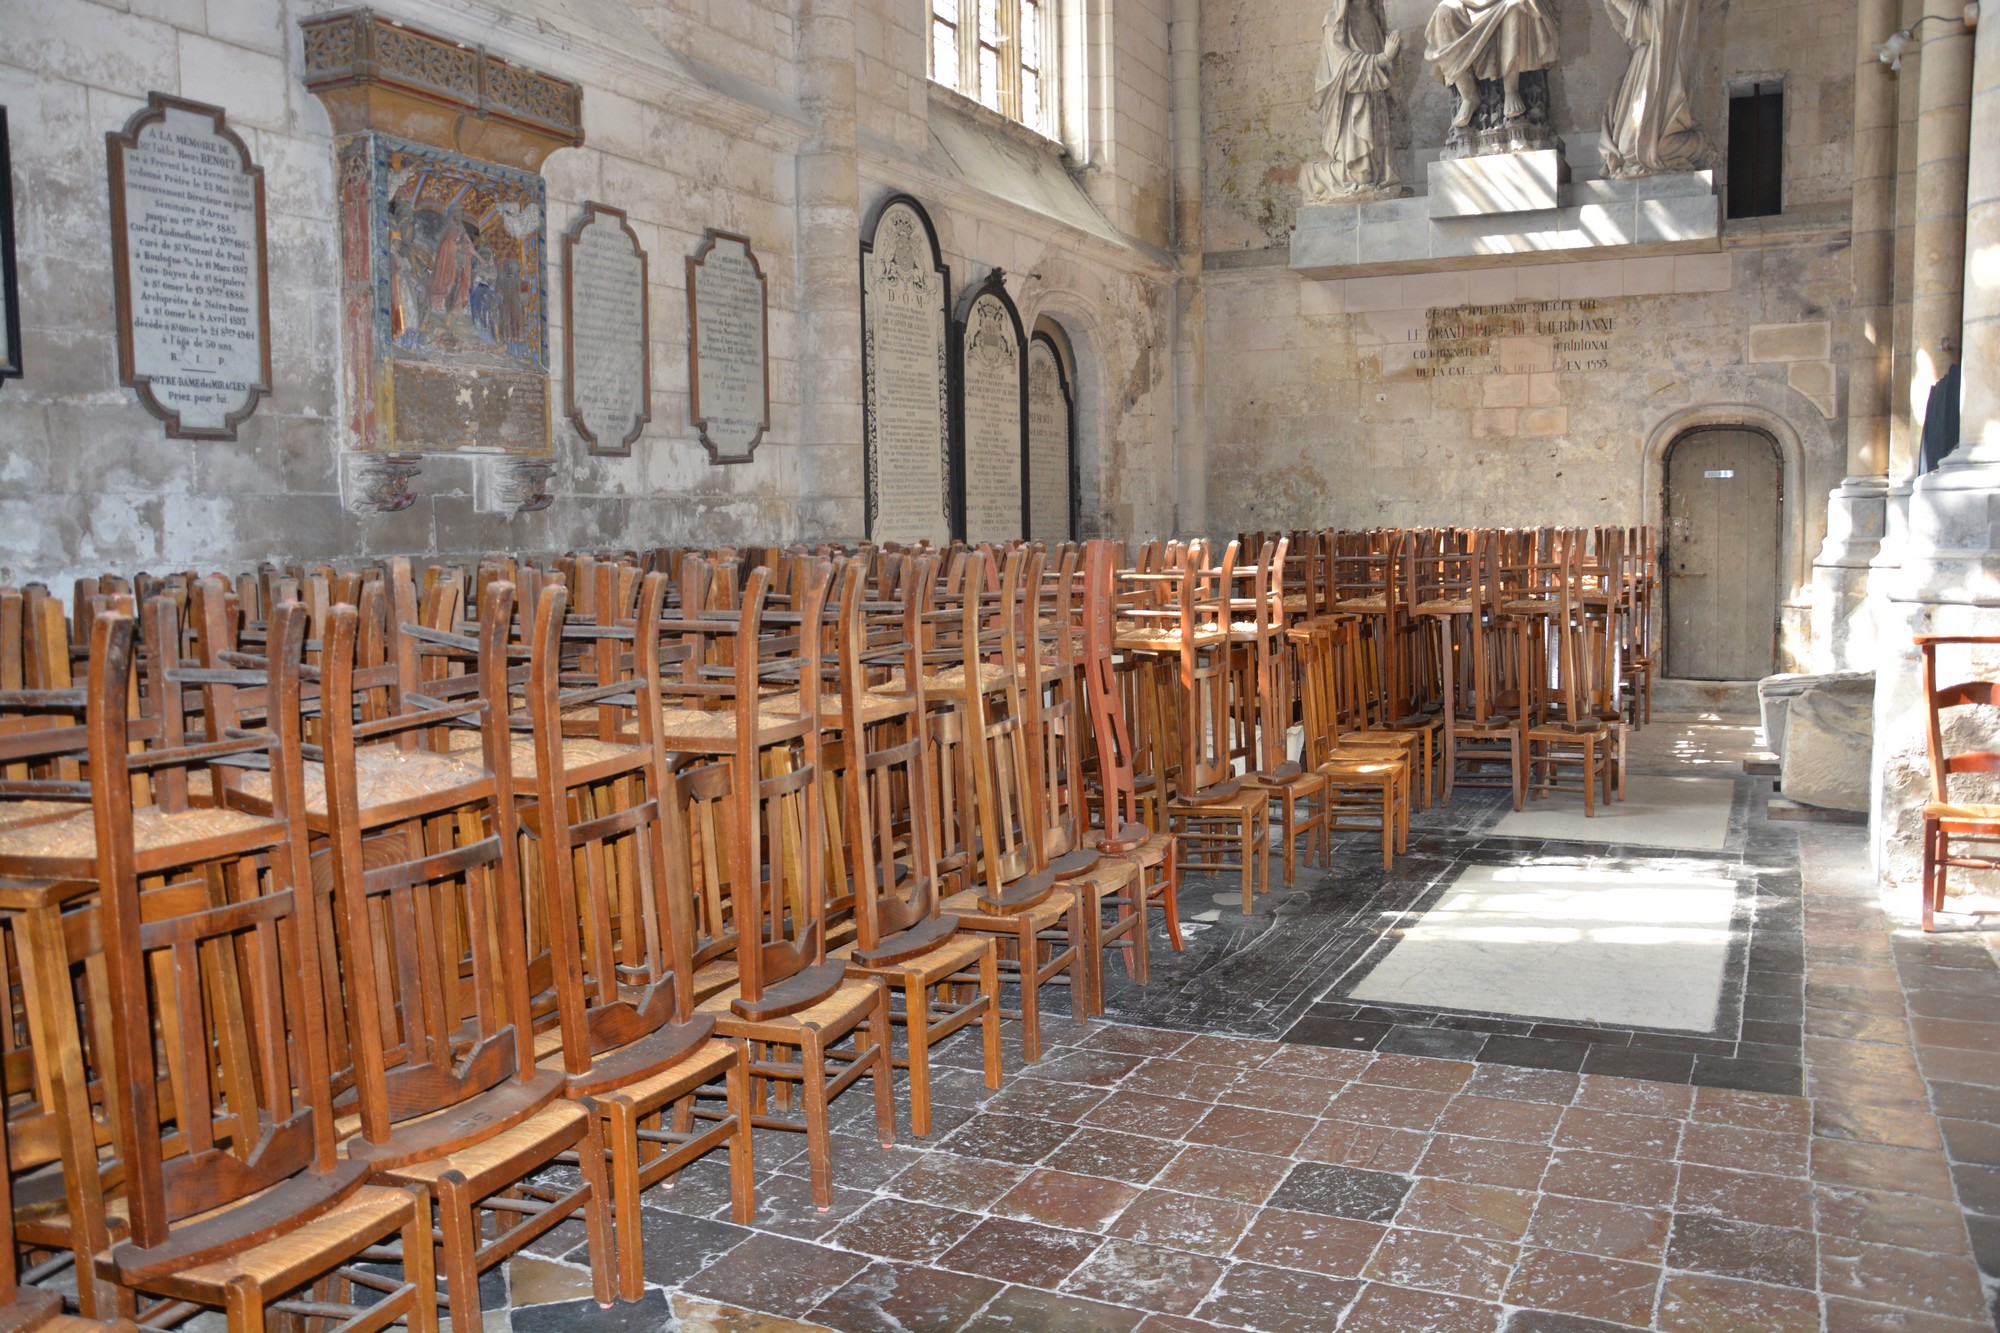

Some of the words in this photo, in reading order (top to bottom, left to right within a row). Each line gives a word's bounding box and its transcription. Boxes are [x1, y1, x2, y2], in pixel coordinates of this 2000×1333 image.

[149, 128, 156, 138] A
[160, 130, 173, 141] LA
[219, 144, 229, 155] DE
[130, 152, 139, 162] né
[182, 162, 189, 172] le
[191, 166, 202, 176] 24
[178, 149, 199, 162] Henri
[201, 153, 237, 170] BENOIT
[193, 178, 201, 189] le
[204, 181, 214, 191] 22
[215, 183, 230, 195] Mai
[187, 192, 223, 207] Directeur
[223, 199, 232, 208] au
[199, 206, 229, 221] d'Arras
[217, 223, 237, 235] 1885
[203, 231, 211, 243] le
[211, 234, 217, 244] 6
[161, 239, 171, 250] de
[183, 244, 213, 257] Vincent
[215, 247, 225, 259] de
[227, 250, 245, 262] Paul
[195, 258, 204, 268] le
[213, 261, 231, 273] Mars
[190, 270, 200, 281] de
[143, 278, 149, 288] à
[163, 281, 184, 292] Omer
[186, 283, 193, 293] le
[225, 289, 245, 301] 1888
[192, 297, 202, 308] de
[144, 304, 150, 315] à
[164, 309, 187, 319] Omer
[188, 310, 196, 320] le
[199, 312, 205, 322] 8
[207, 313, 227, 325] Avril
[229, 315, 247, 327] 1893
[179, 323, 200, 334] Omer
[201, 324, 208, 335] le
[237, 330, 255, 341] 1901
[1428, 323, 1465, 340] GRAND
[162, 335, 167, 345] à
[193, 337, 203, 347] de
[205, 339, 216, 349] 50
[1415, 367, 1429, 378] DE
[1432, 367, 1445, 377] LA
[1566, 360, 1581, 372] EN
[1585, 358, 1609, 370] 1553
[211, 379, 247, 391] MIRACLES
[168, 390, 191, 402] Priez
[194, 393, 213, 405] pour
